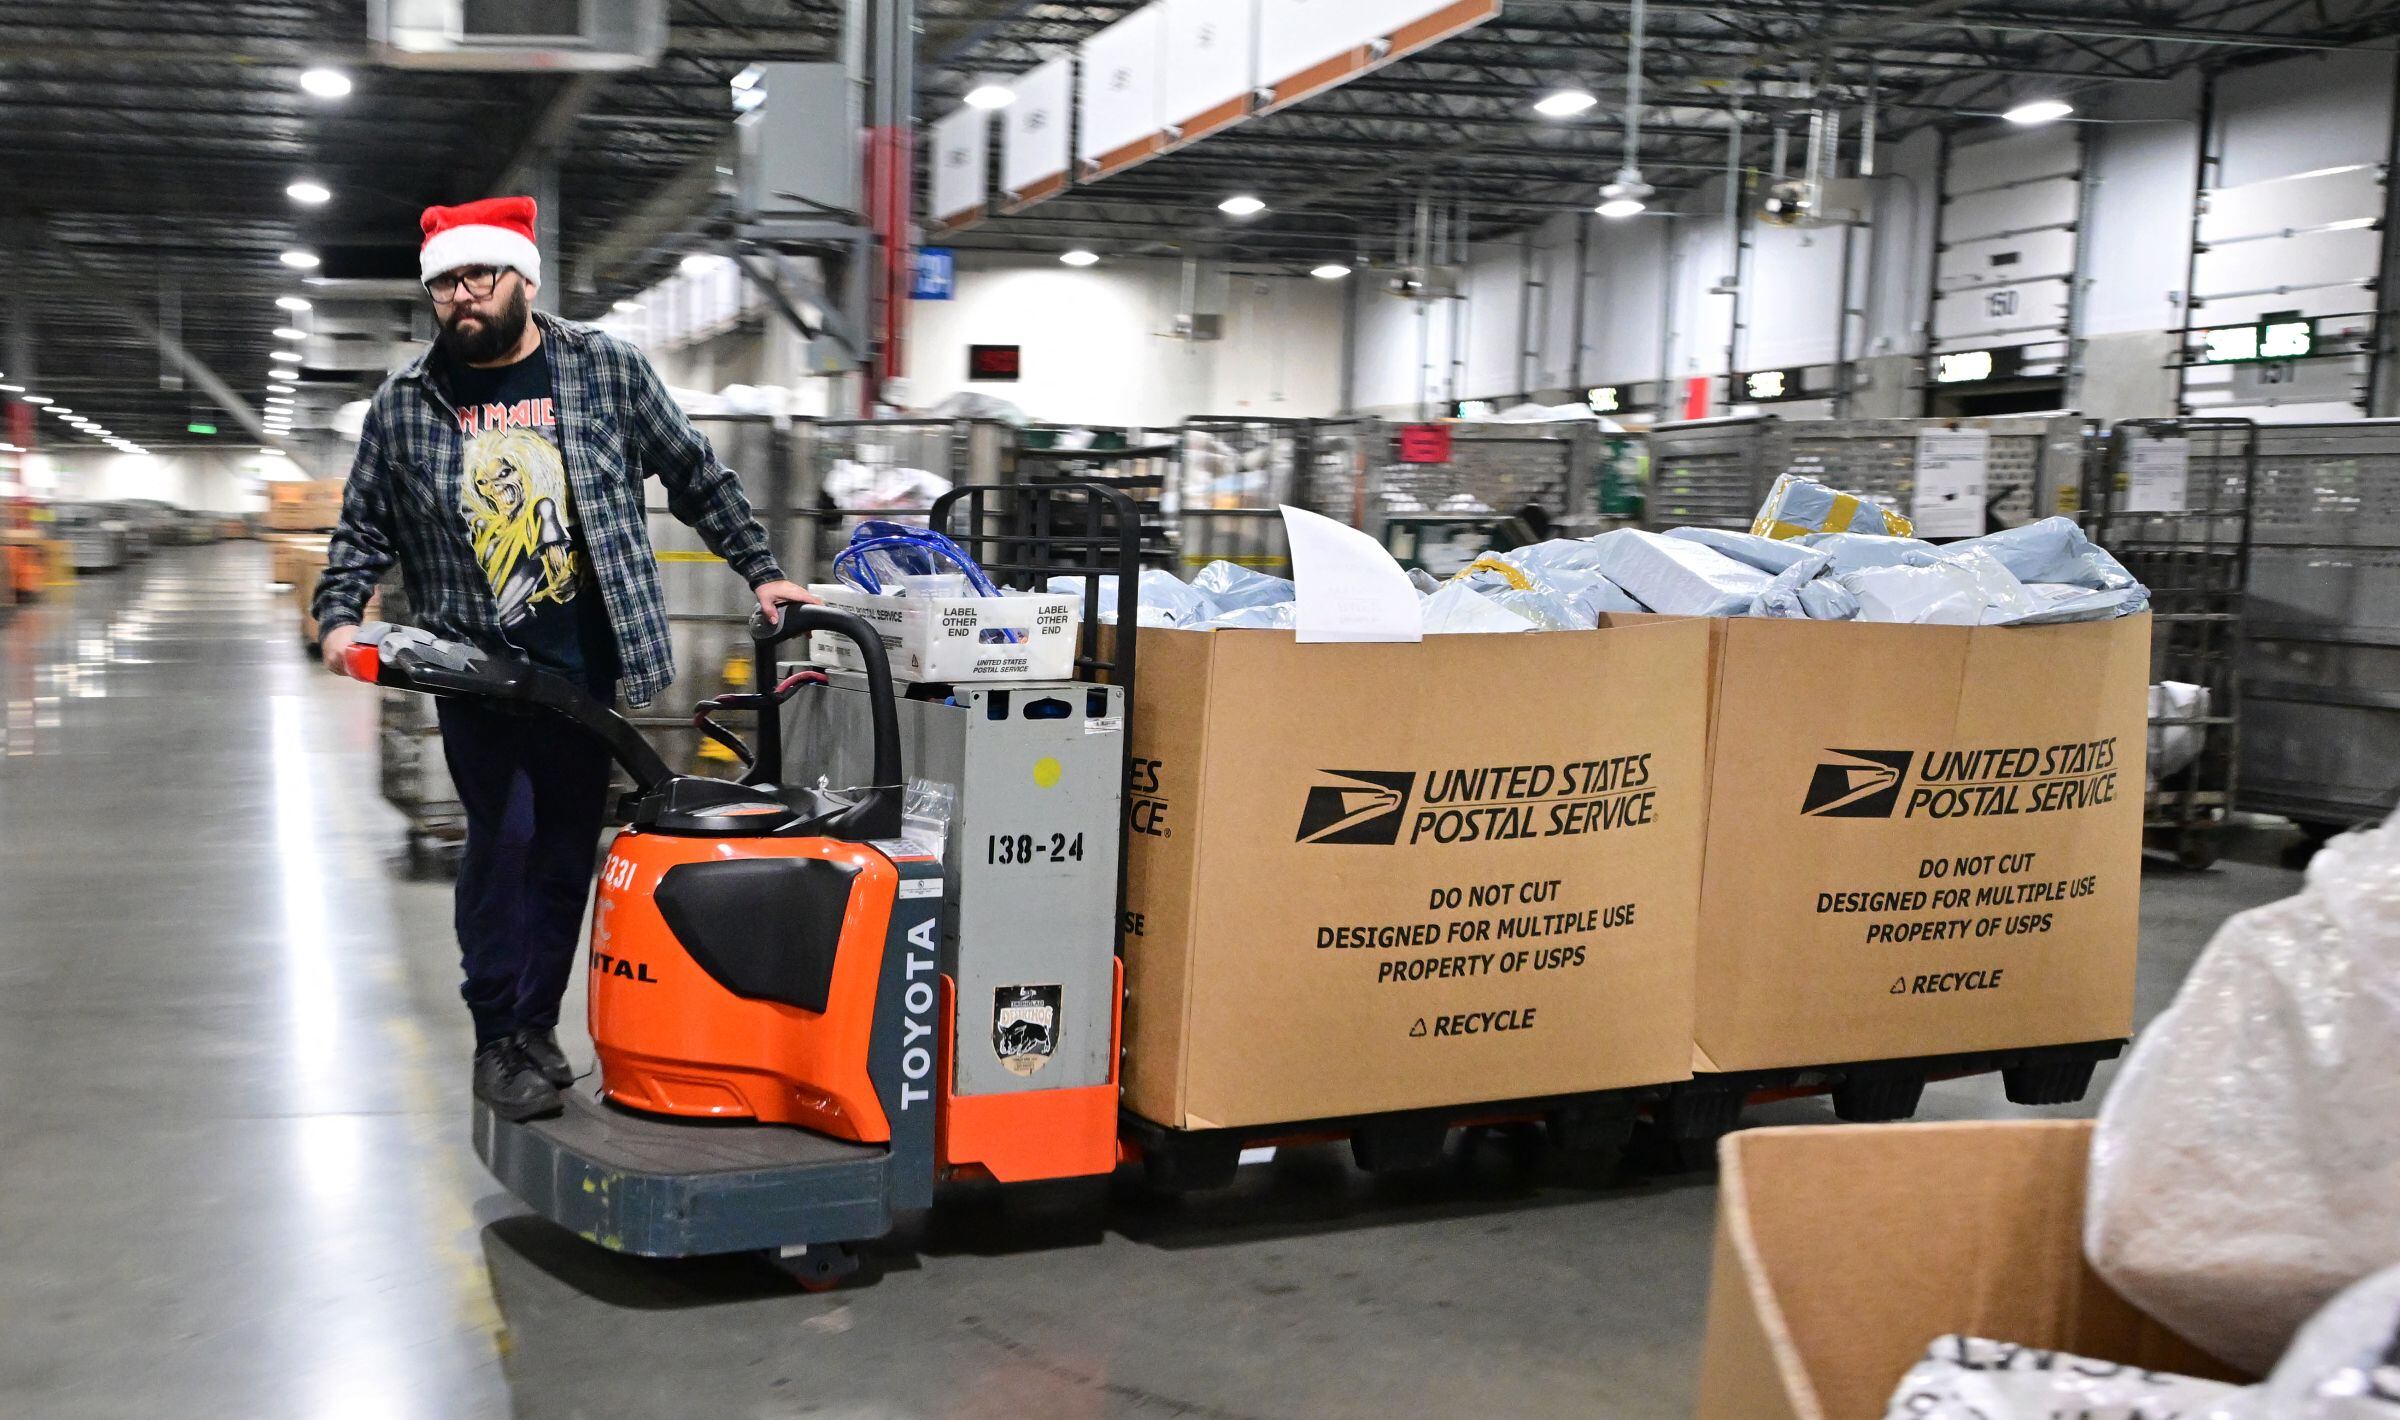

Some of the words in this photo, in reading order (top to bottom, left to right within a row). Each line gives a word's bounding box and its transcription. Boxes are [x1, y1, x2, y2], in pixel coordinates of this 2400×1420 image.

[942, 617, 977, 626] OTHER
[944, 607, 977, 616] LABEL
[1036, 615, 1068, 625] OTHER
[1038, 605, 1069, 615] LABEL
[948, 628, 969, 637] END
[1042, 626, 1061, 635] END
[1920, 747, 2041, 782] UNITED
[2039, 737, 2117, 777] STATES
[1423, 764, 1554, 804] UNITED
[1558, 753, 1652, 797] STATES
[1904, 784, 2020, 819] POSTAL
[1410, 806, 1537, 845] POSTAL
[988, 832, 1084, 865] 138-24
[1918, 858, 1948, 879] DO
[1953, 855, 1995, 877] NOT
[1998, 852, 2035, 874] CUT
[1429, 887, 1462, 910] DO
[1469, 883, 1514, 908] NOT
[1519, 879, 1561, 904] CUT
[1816, 891, 1927, 913] DESIGNED
[1931, 888, 1971, 910] FOR
[1975, 880, 2067, 907] MULTIPLE
[2070, 875, 2097, 899] USE
[1316, 923, 1441, 948] DESIGNED
[1447, 919, 1490, 944] FOR
[1497, 909, 1597, 940] MULTIPLE
[1603, 903, 1635, 929] USE
[1866, 919, 1972, 944] PROPERTY
[1975, 917, 2002, 938] OF
[2005, 913, 2053, 935] USPS
[1378, 953, 1494, 983] PROPERTY
[1499, 950, 1529, 973] OF
[1534, 945, 1586, 970] USPS
[1911, 969, 2004, 994] RECYCLE
[901, 917, 936, 1111] TOYOTA
[1434, 1007, 1537, 1037] RECYCLE
